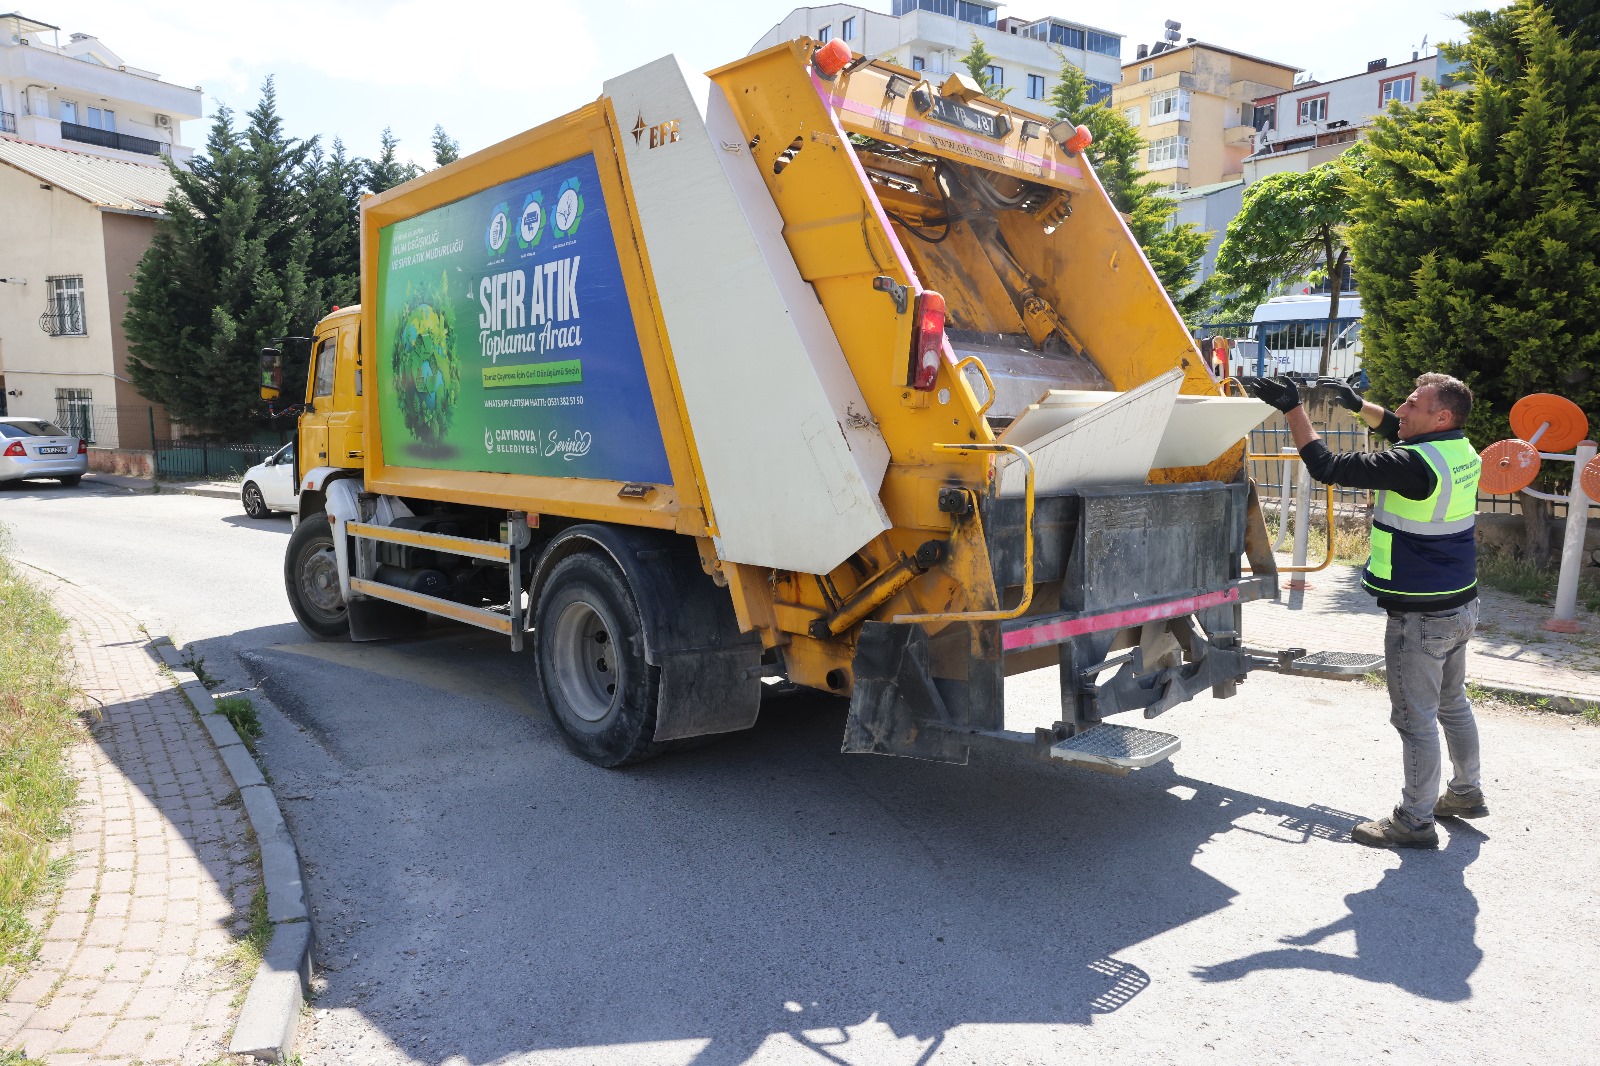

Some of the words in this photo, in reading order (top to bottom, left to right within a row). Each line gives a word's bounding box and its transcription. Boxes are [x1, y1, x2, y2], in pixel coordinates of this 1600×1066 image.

[974, 113, 994, 133] 787
[412, 251, 425, 265] ATIK
[479, 269, 526, 332] SIFIR
[531, 255, 580, 326] ATIK
[479, 329, 536, 364] Toplama
[538, 320, 583, 355] Aracı
[483, 399, 509, 408] WHATSAPP
[495, 429, 537, 442] ÇAYIROVA
[496, 443, 538, 454] BELEDİYESİ
[544, 429, 592, 461] Sevince
